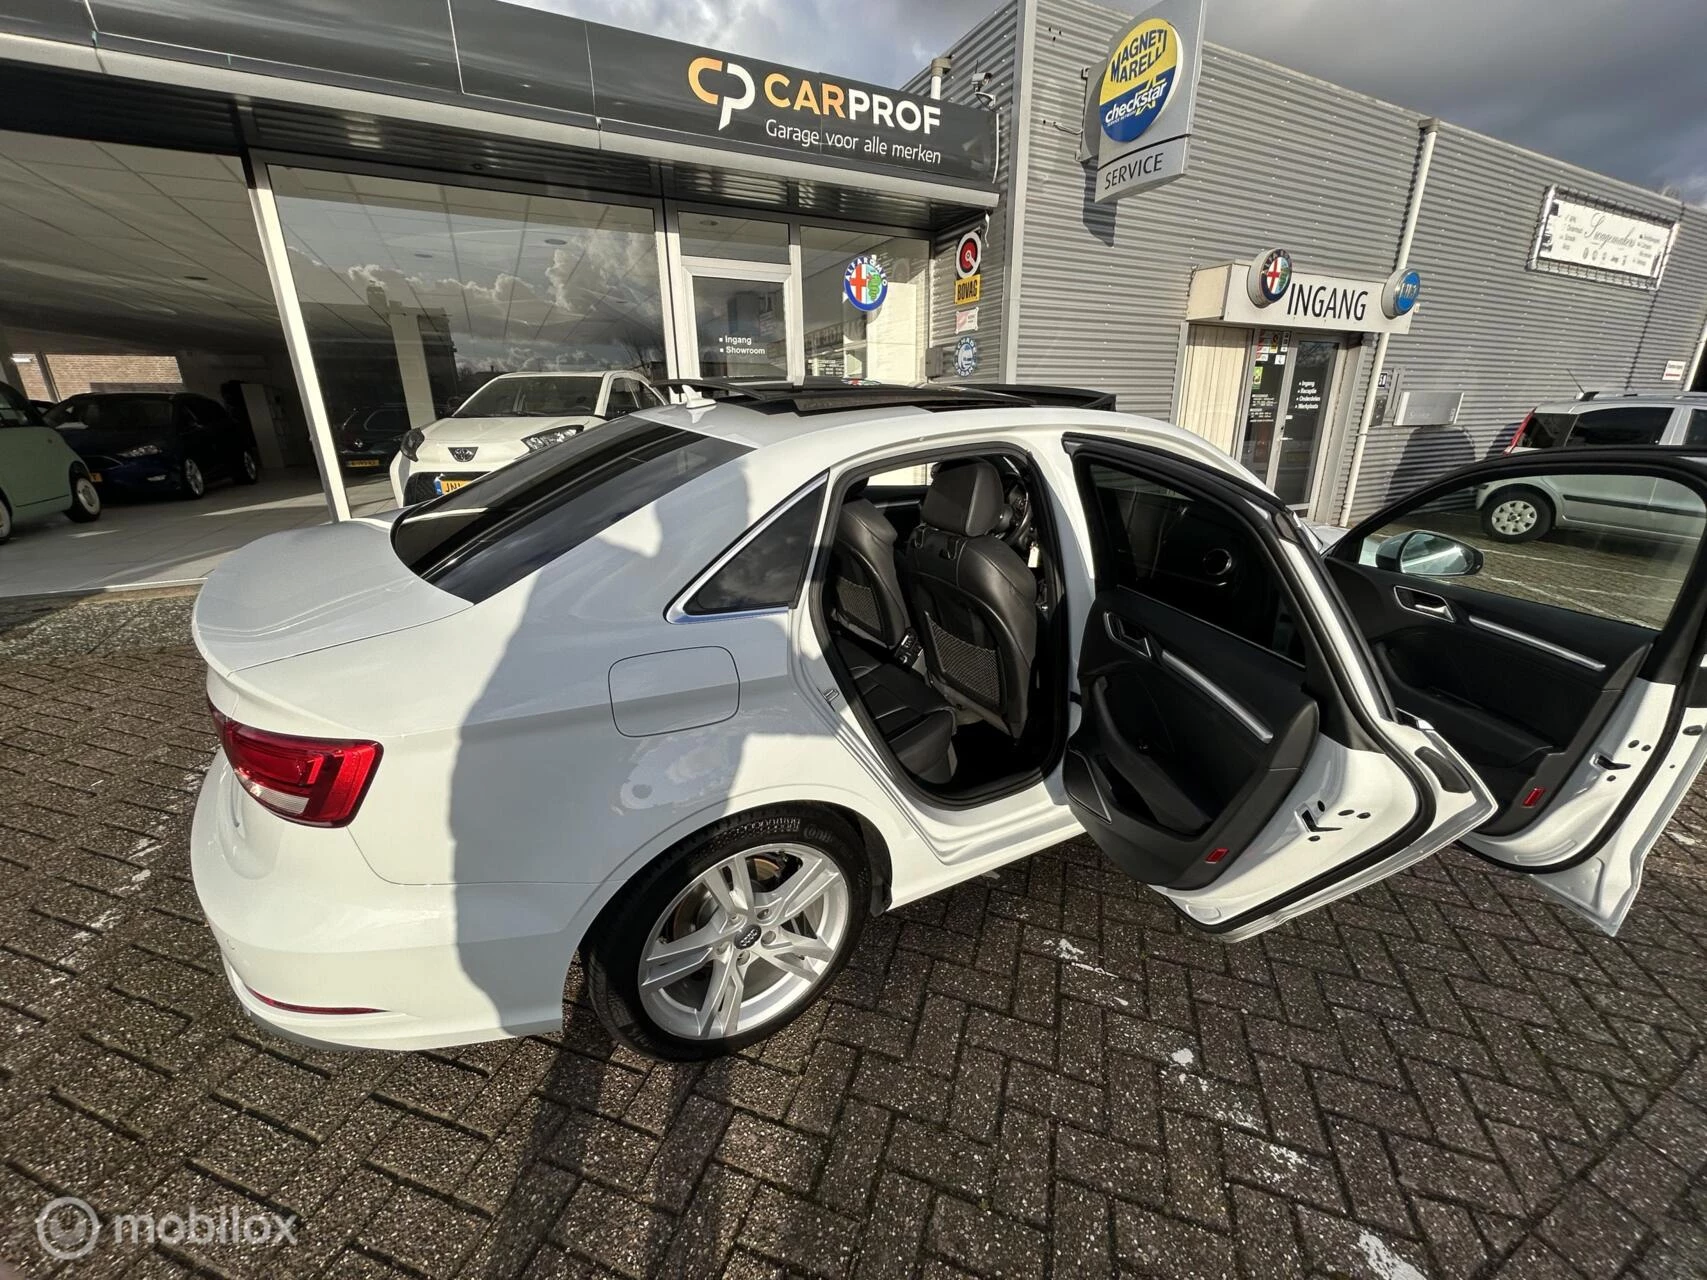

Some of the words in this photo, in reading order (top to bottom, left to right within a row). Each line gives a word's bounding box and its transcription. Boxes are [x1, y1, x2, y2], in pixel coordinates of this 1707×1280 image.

[763, 72, 942, 135] CARPROF
[1105, 82, 1167, 123] checkstar
[766, 118, 820, 147] Garage
[825, 131, 859, 150] voor
[864, 136, 887, 155] alle
[892, 144, 941, 164] merken
[1105, 152, 1164, 190] SERVICE
[957, 279, 978, 300] BOVAG
[1287, 283, 1368, 321] INGANG
[725, 335, 752, 345] Ingang
[726, 346, 766, 355] Showroom
